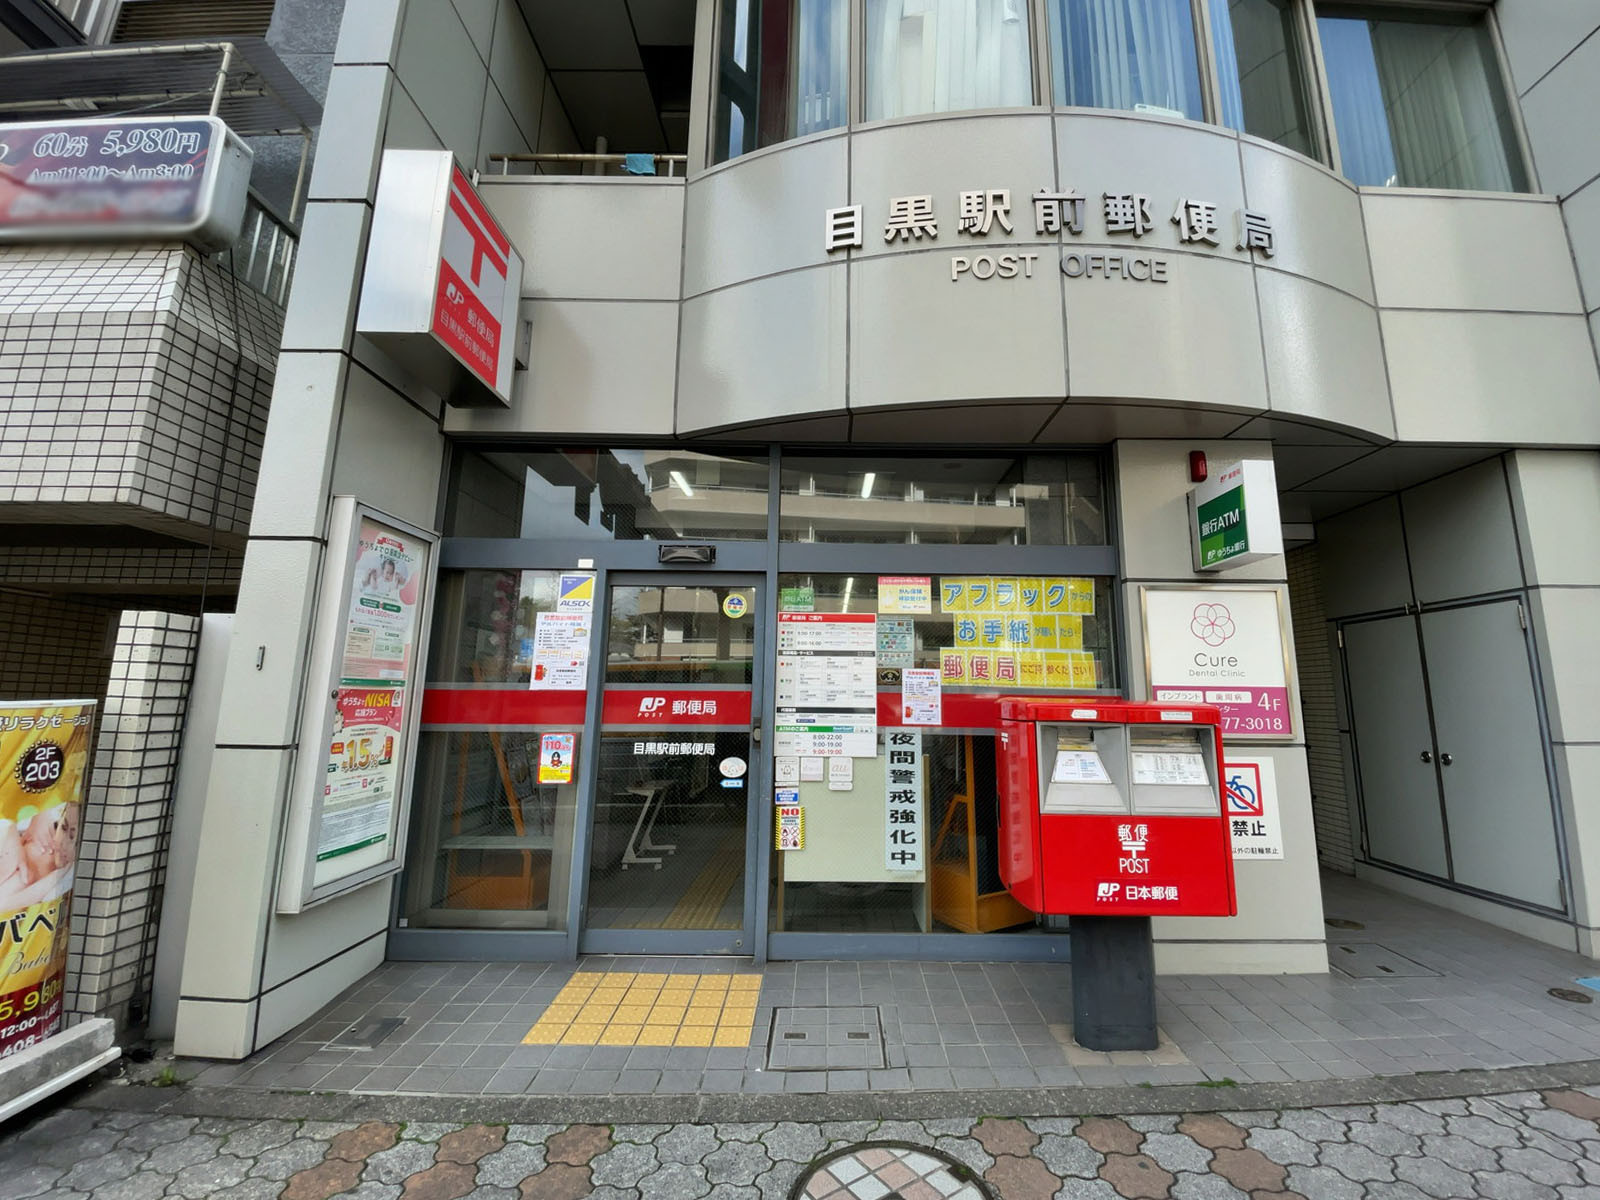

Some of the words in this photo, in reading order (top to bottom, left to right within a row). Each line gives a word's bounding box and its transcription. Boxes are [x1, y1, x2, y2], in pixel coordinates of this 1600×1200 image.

[33, 132, 88, 157] 60分
[100, 128, 200, 157] 5,980円
[825, 188, 1276, 258] 目黒駅前郵便局
[951, 253, 1038, 281] POST
[1060, 254, 1168, 283] OFFICE
[467, 309, 495, 347] 郵便局
[1202, 508, 1240, 537] 銀行ATM
[1217, 540, 1246, 557] ゆうちょ銀行
[1194, 652, 1238, 667] Cure
[1189, 669, 1218, 677] Dental
[671, 700, 717, 715] 郵便局
[1257, 692, 1281, 711] 4F
[35, 747, 57, 761] 2F
[633, 742, 715, 756] 目黒駅前郵便局
[25, 761, 60, 782] 203
[889, 731, 916, 865] 夜間警戒強化中
[781, 808, 799, 816] NO
[1118, 824, 1149, 842] 郵便
[1232, 820, 1266, 837] 禁止
[1119, 858, 1150, 873] POST
[1126, 886, 1179, 901] 日本郵便
